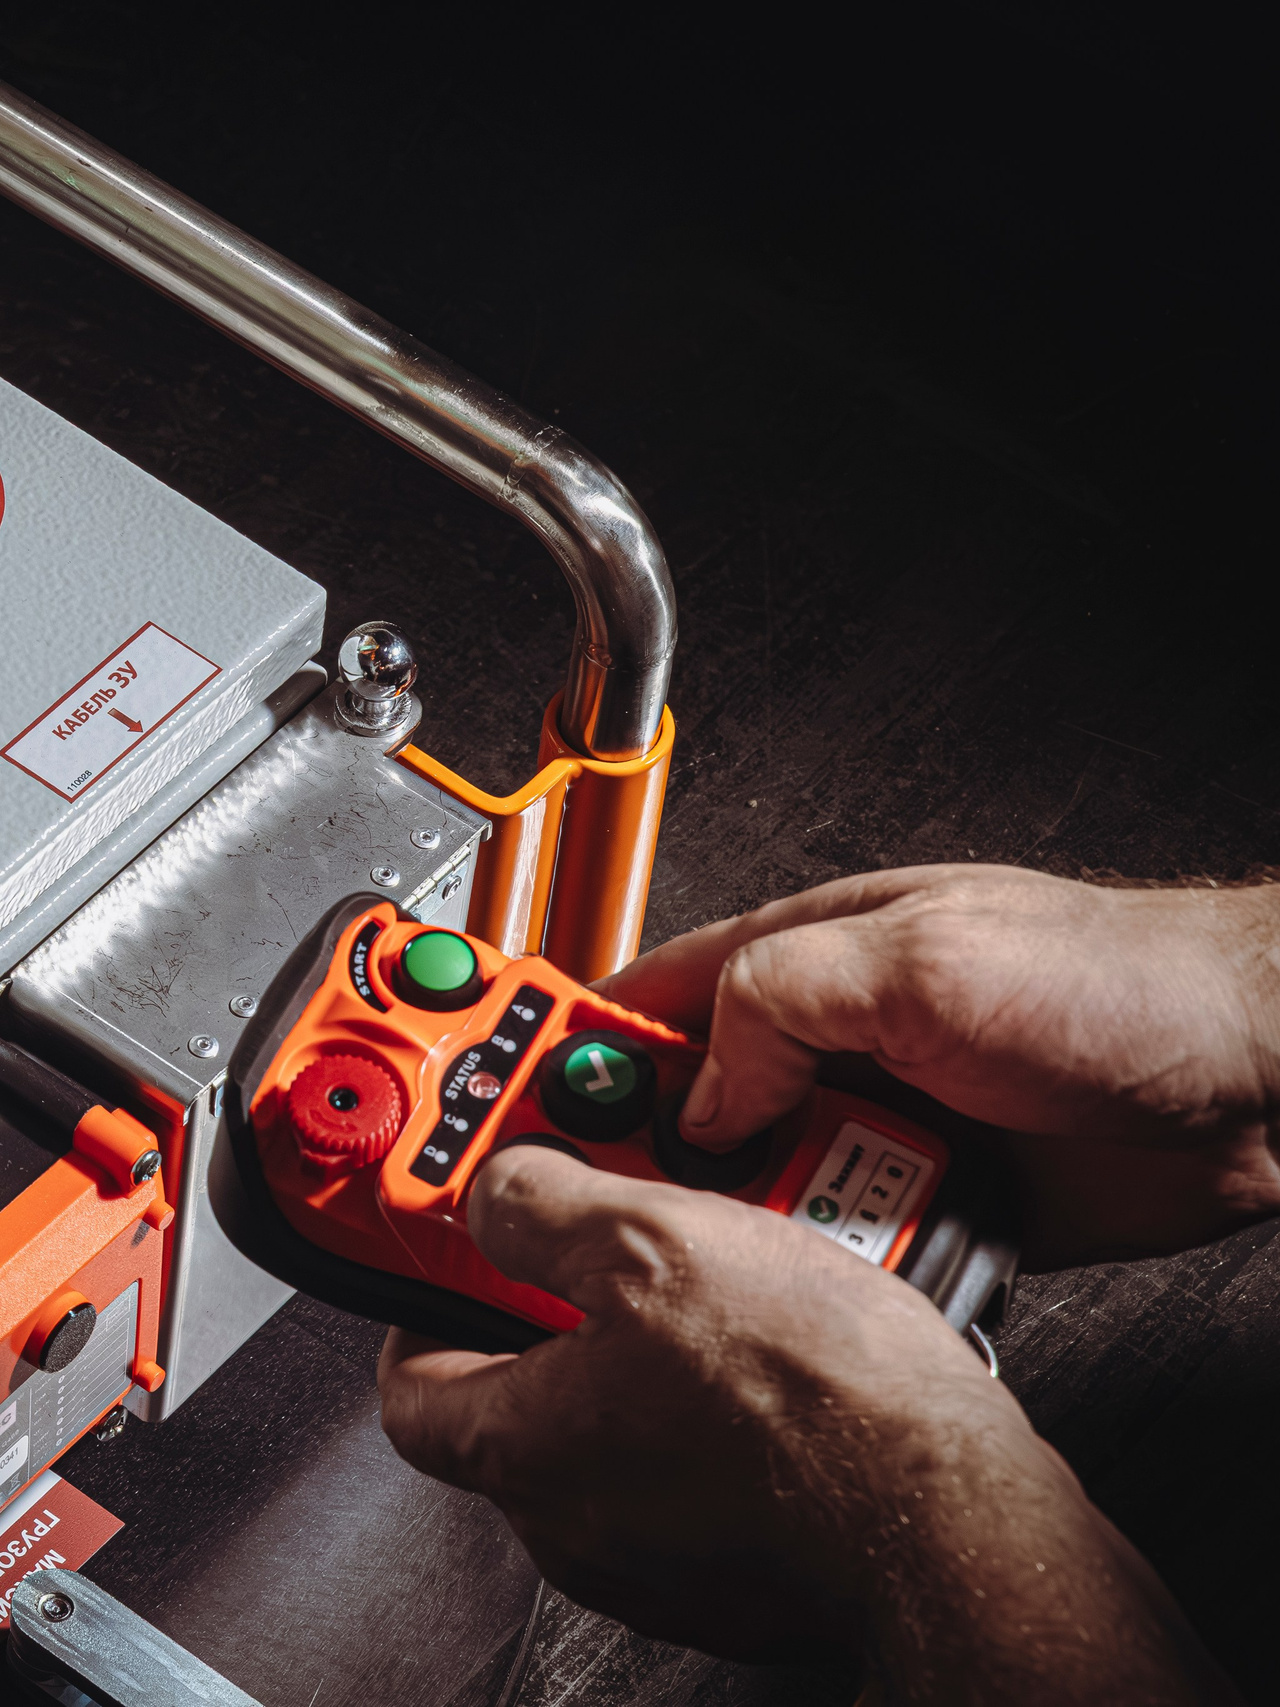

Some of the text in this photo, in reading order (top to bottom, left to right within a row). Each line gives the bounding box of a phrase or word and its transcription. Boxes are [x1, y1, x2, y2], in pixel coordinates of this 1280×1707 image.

[51, 659, 138, 741] КАБЕЛЬ ЗУ
[66, 769, 93, 793] 110028
[352, 942, 371, 997] START
[511, 1004, 524, 1015] A
[491, 1034, 504, 1047] B
[444, 1051, 481, 1101] STATUS
[443, 1113, 456, 1125] C
[423, 1145, 437, 1158] D
